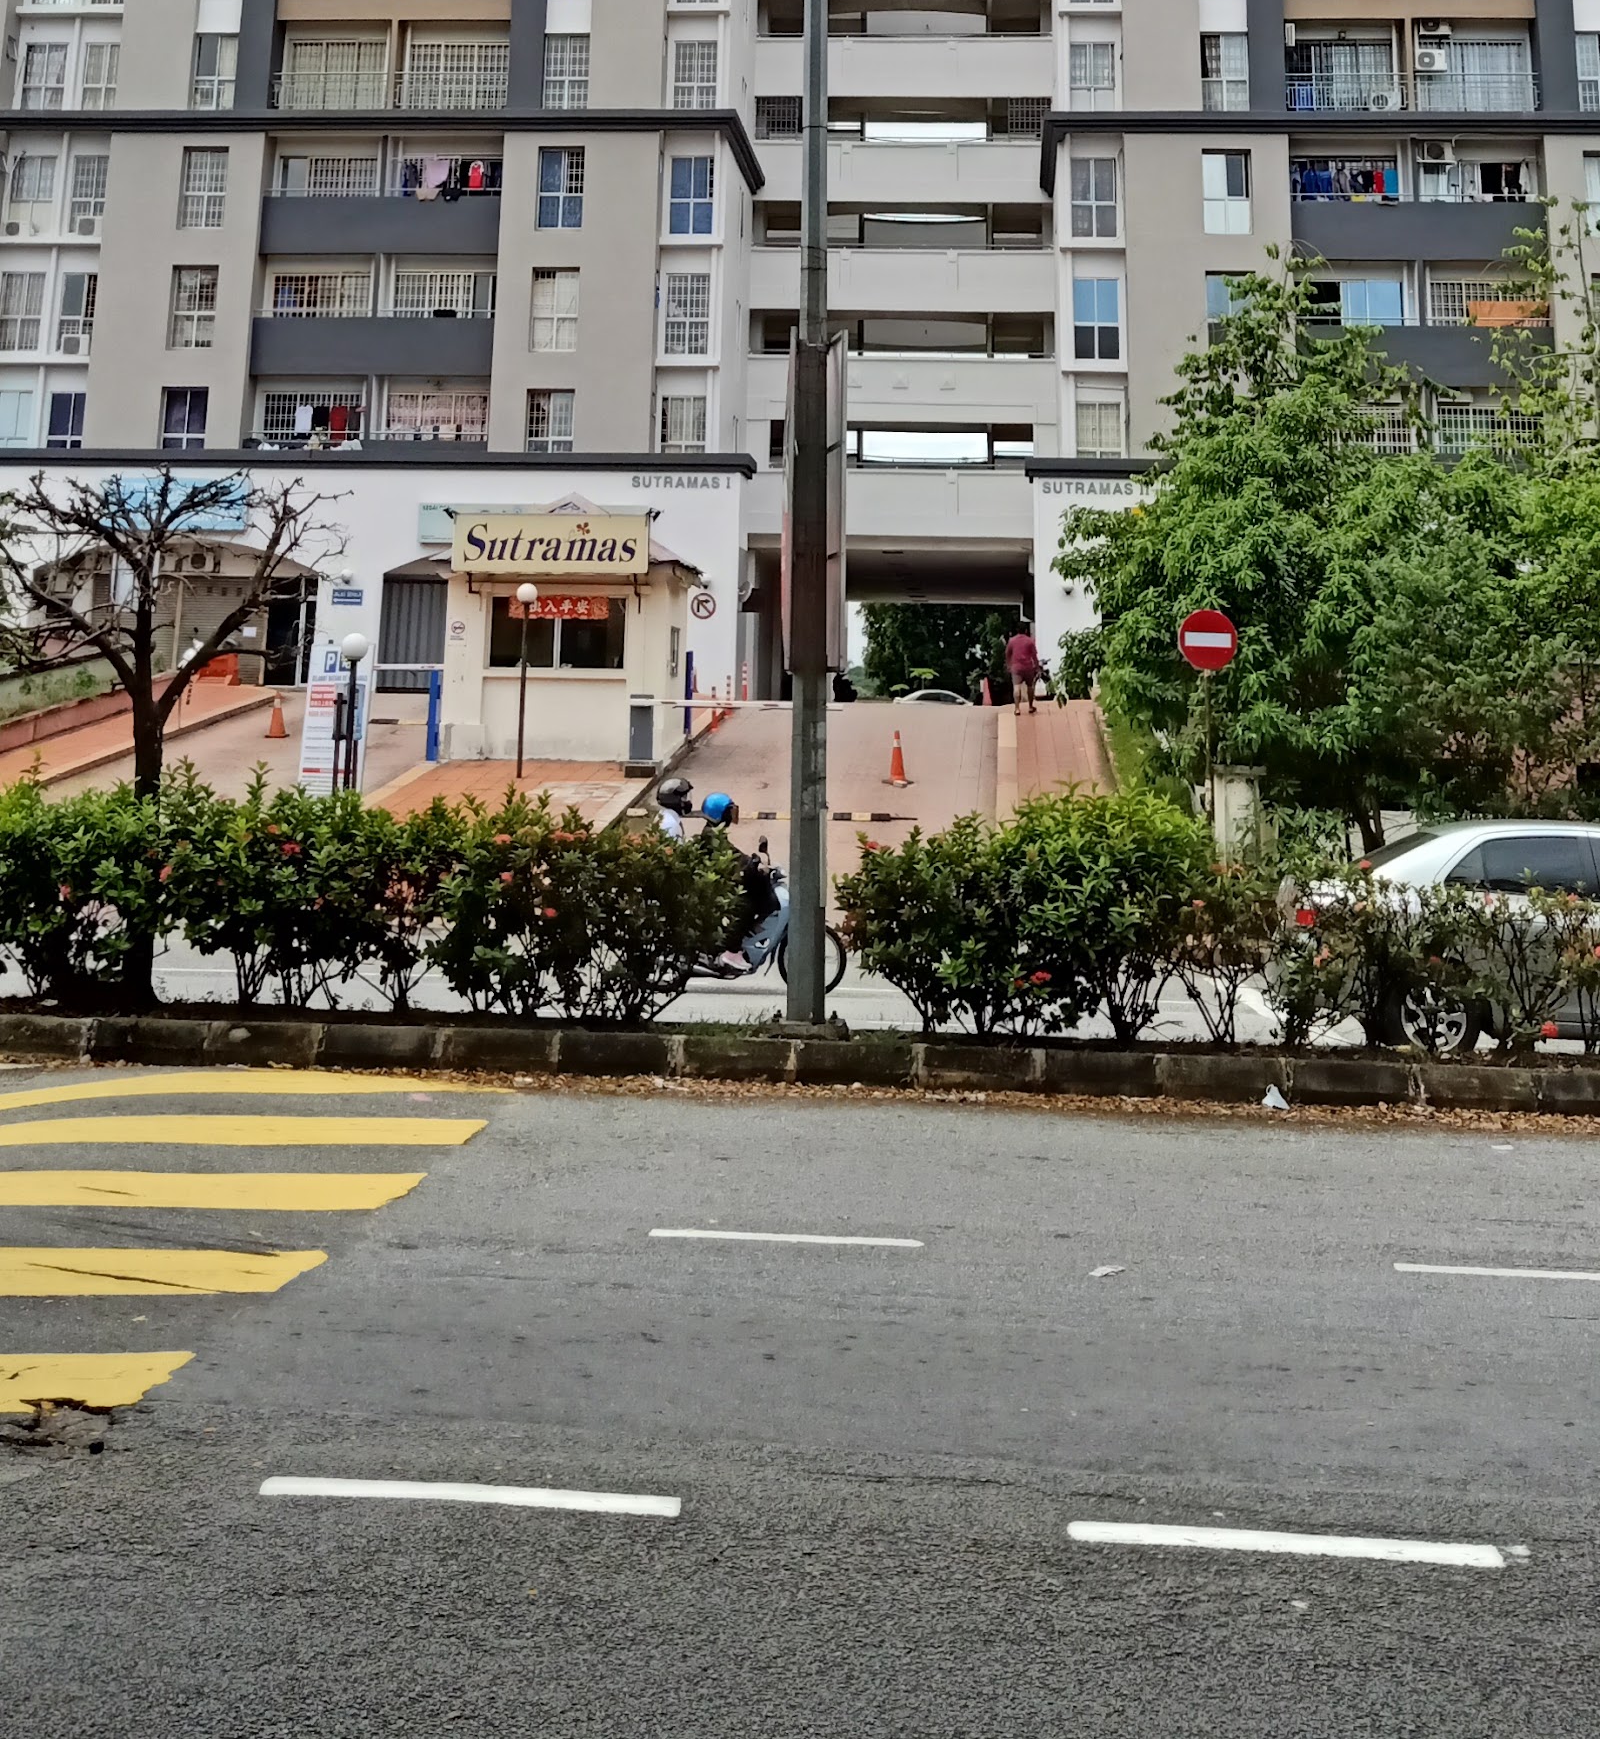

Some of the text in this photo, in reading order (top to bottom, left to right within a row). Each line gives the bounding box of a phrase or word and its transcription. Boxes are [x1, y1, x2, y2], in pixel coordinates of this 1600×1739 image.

[631, 475, 720, 490] SUTRAMAS
[1042, 481, 1133, 495] SUTRAMAS
[463, 523, 637, 562] Sutramas
[529, 599, 589, 614] 出入平安
